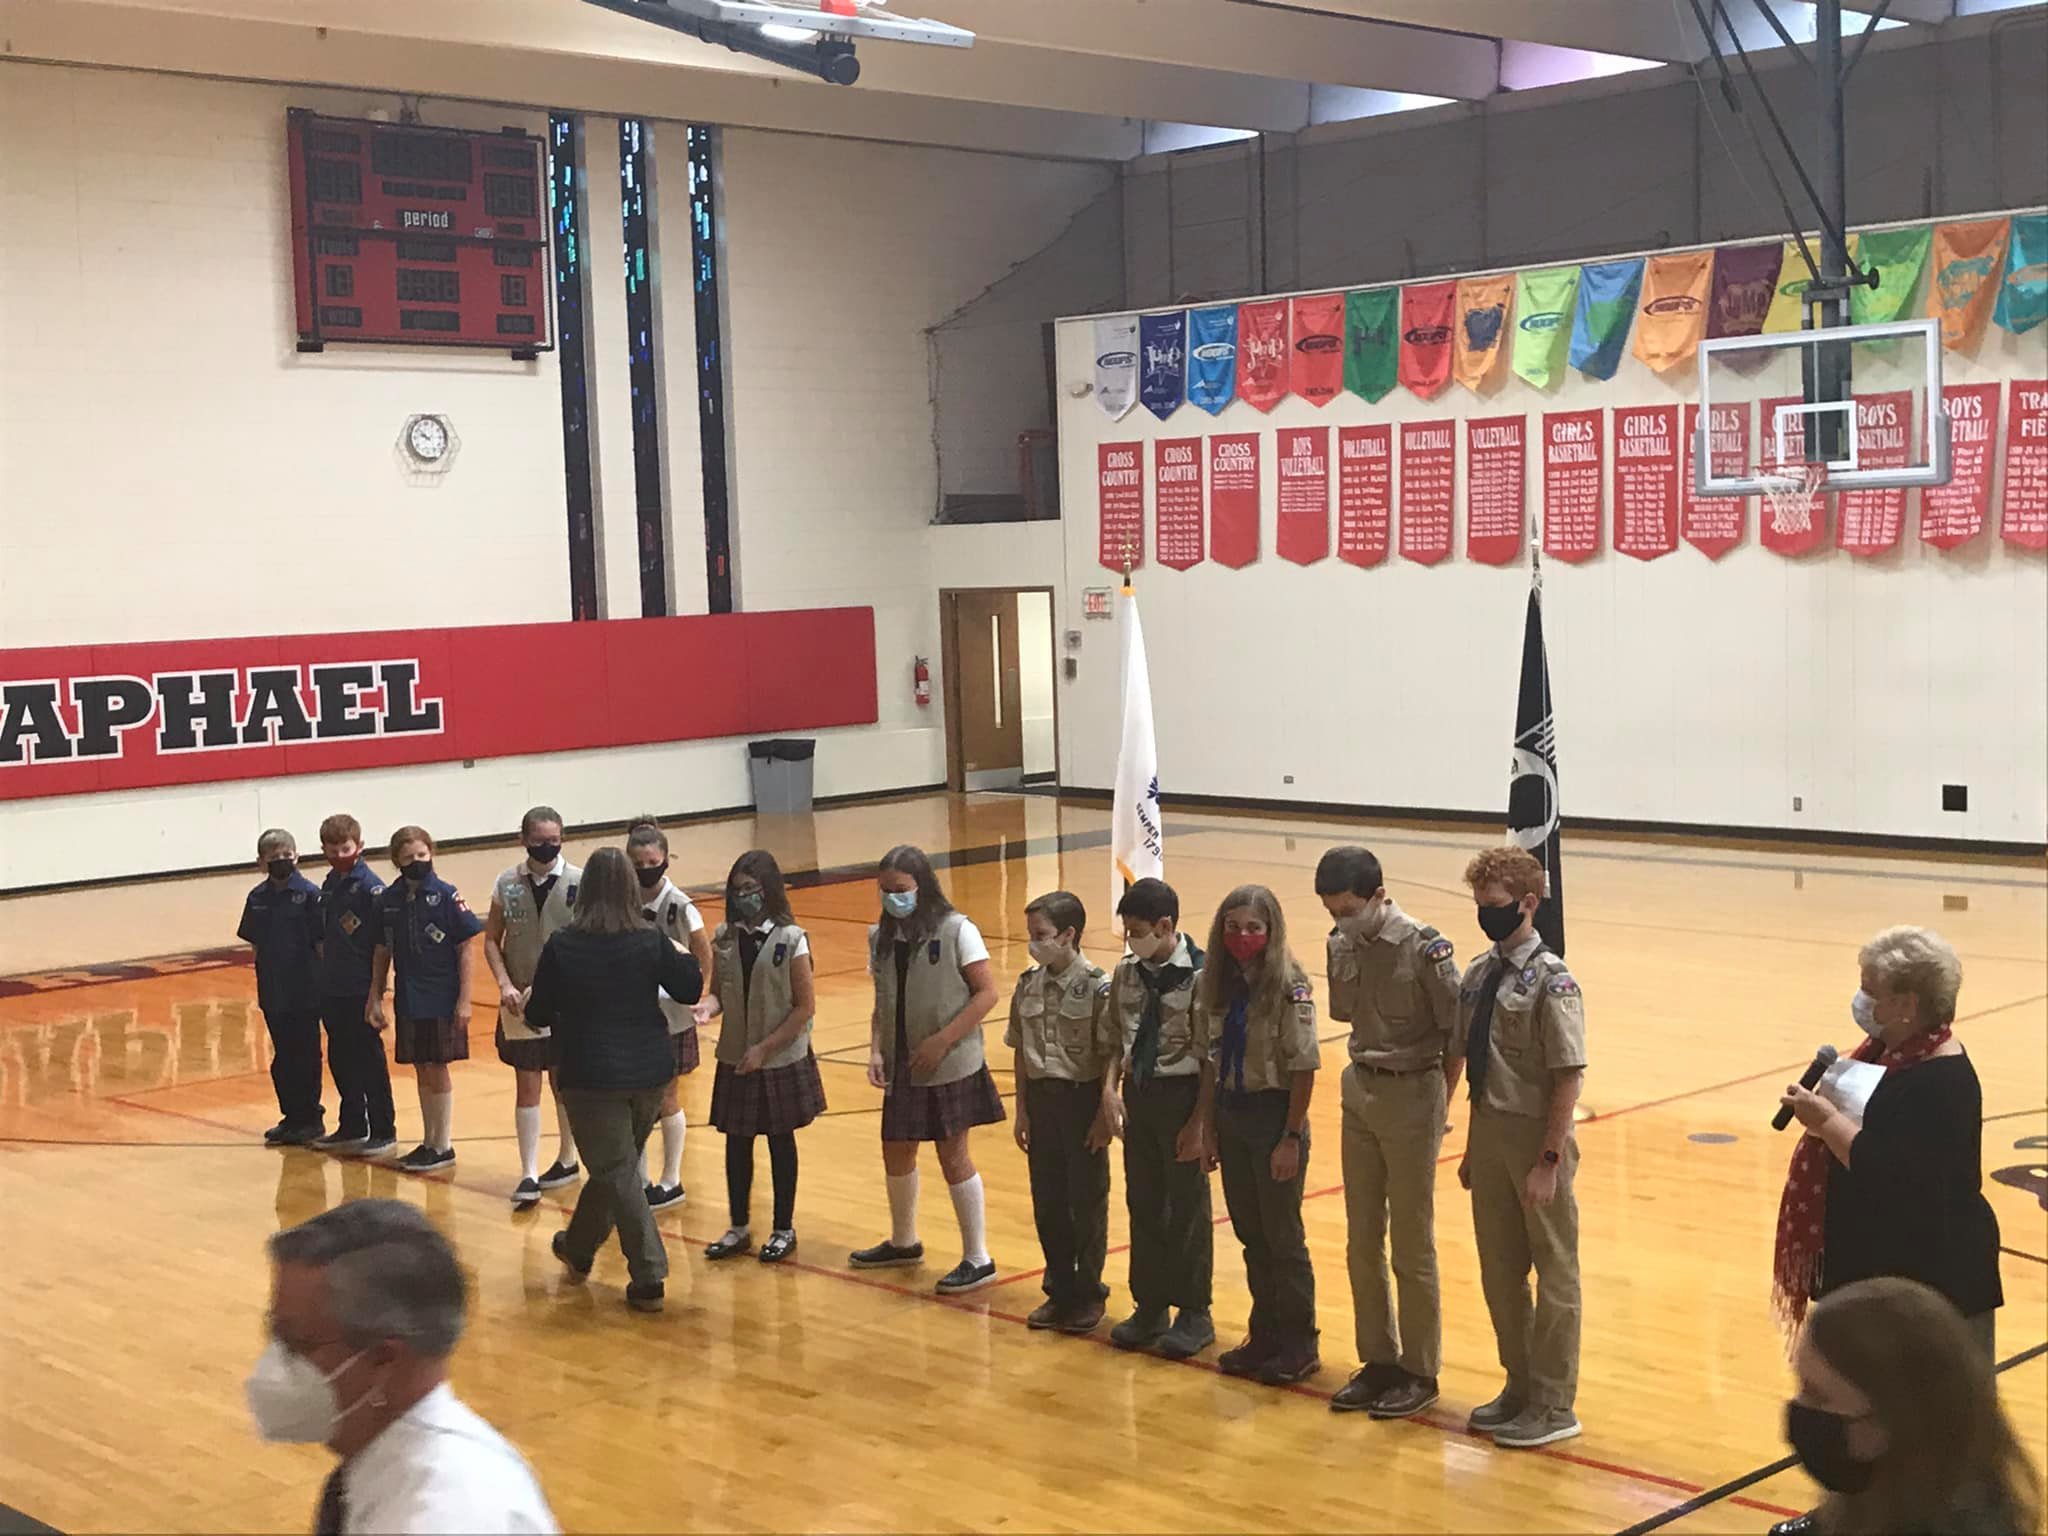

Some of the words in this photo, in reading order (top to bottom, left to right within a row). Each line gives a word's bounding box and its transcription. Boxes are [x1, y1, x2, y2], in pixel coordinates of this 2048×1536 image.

[403, 210, 449, 229] period
[1624, 414, 1667, 436] GIRLS
[1859, 403, 1897, 426] BOYS
[1472, 425, 1520, 448] VOLLEYBALL
[1552, 421, 1594, 443] GIRLS
[1218, 443, 1251, 456] CROSS
[1548, 442, 1598, 464] BASKETBALL
[1619, 437, 1671, 457] BASKETBALL
[1159, 465, 1198, 482] COUNTRY
[1213, 457, 1256, 471] COUNTRY
[1102, 470, 1140, 486] COUNTRY
[1136, 802, 1160, 841] SEMPER
